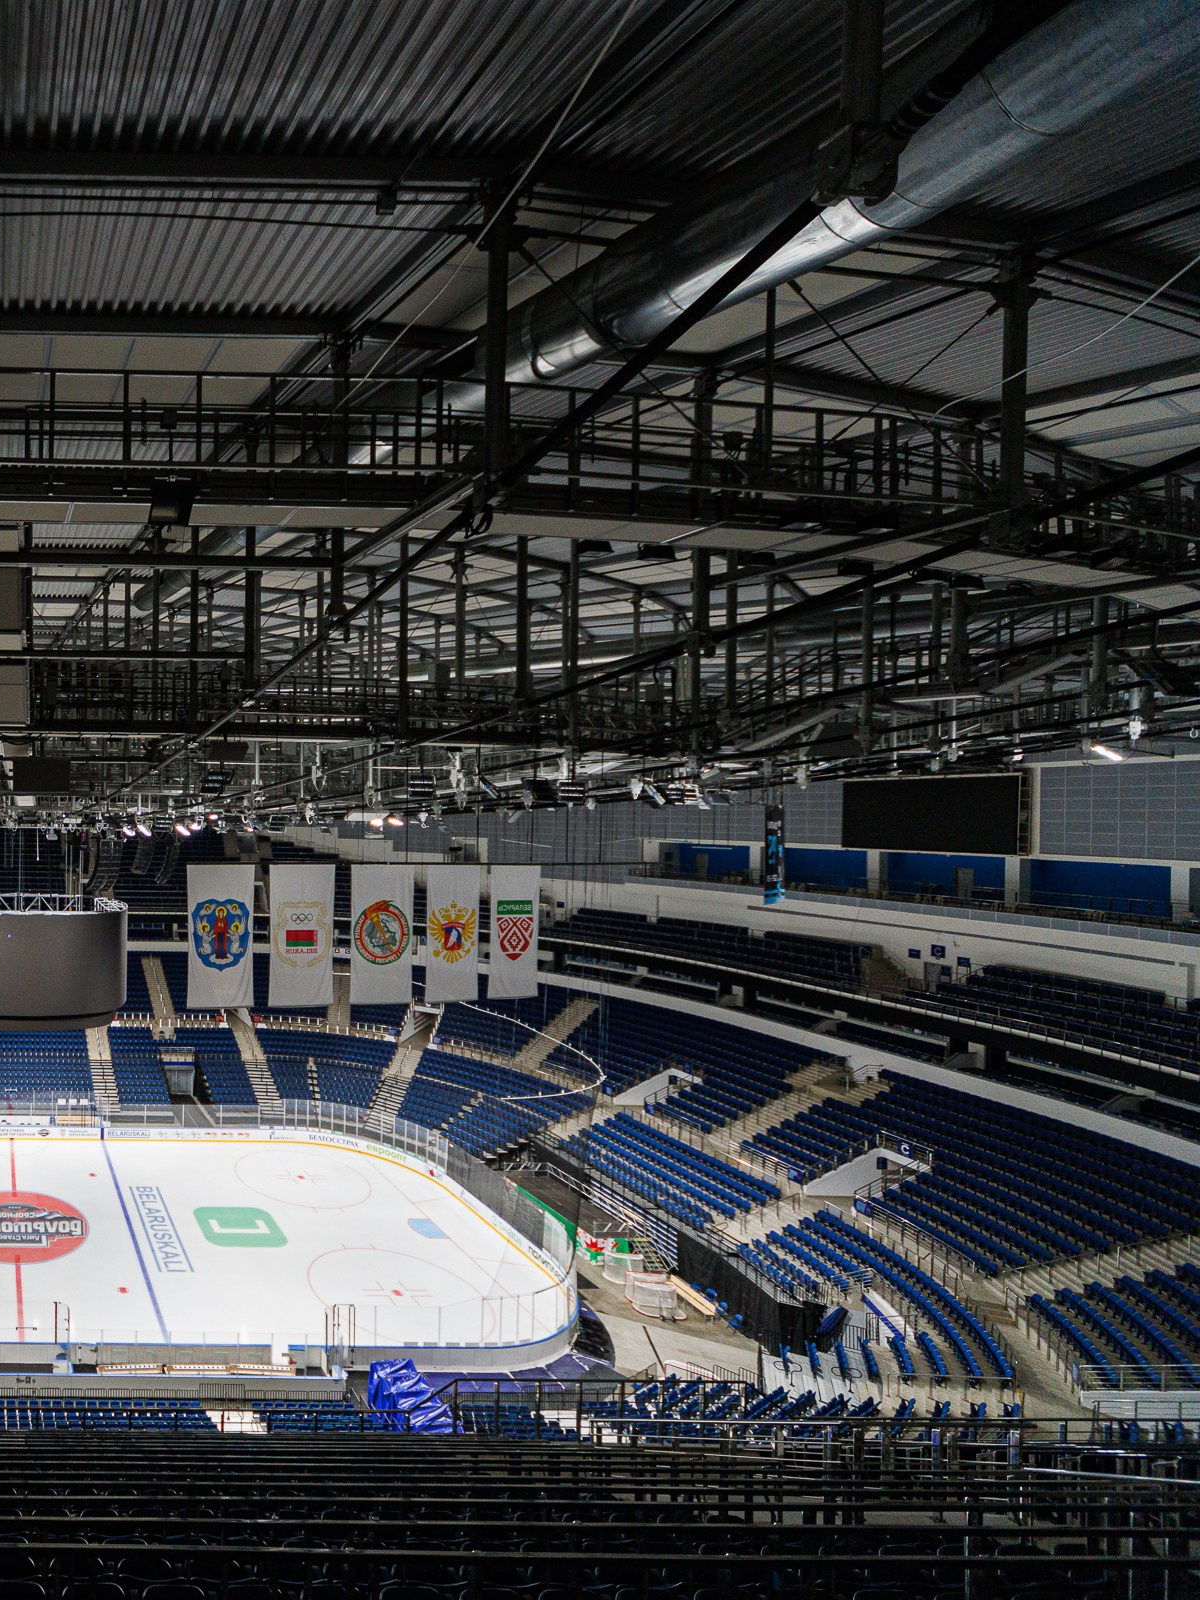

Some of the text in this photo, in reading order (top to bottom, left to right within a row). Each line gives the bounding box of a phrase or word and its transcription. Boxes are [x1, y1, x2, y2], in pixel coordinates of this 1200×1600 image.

[308, 1133, 360, 1148] БЕЛГОССТРАХ
[366, 1144, 408, 1163] евроопт
[900, 1144, 910, 1155] C
[135, 1186, 187, 1272] BELARUSKALI
